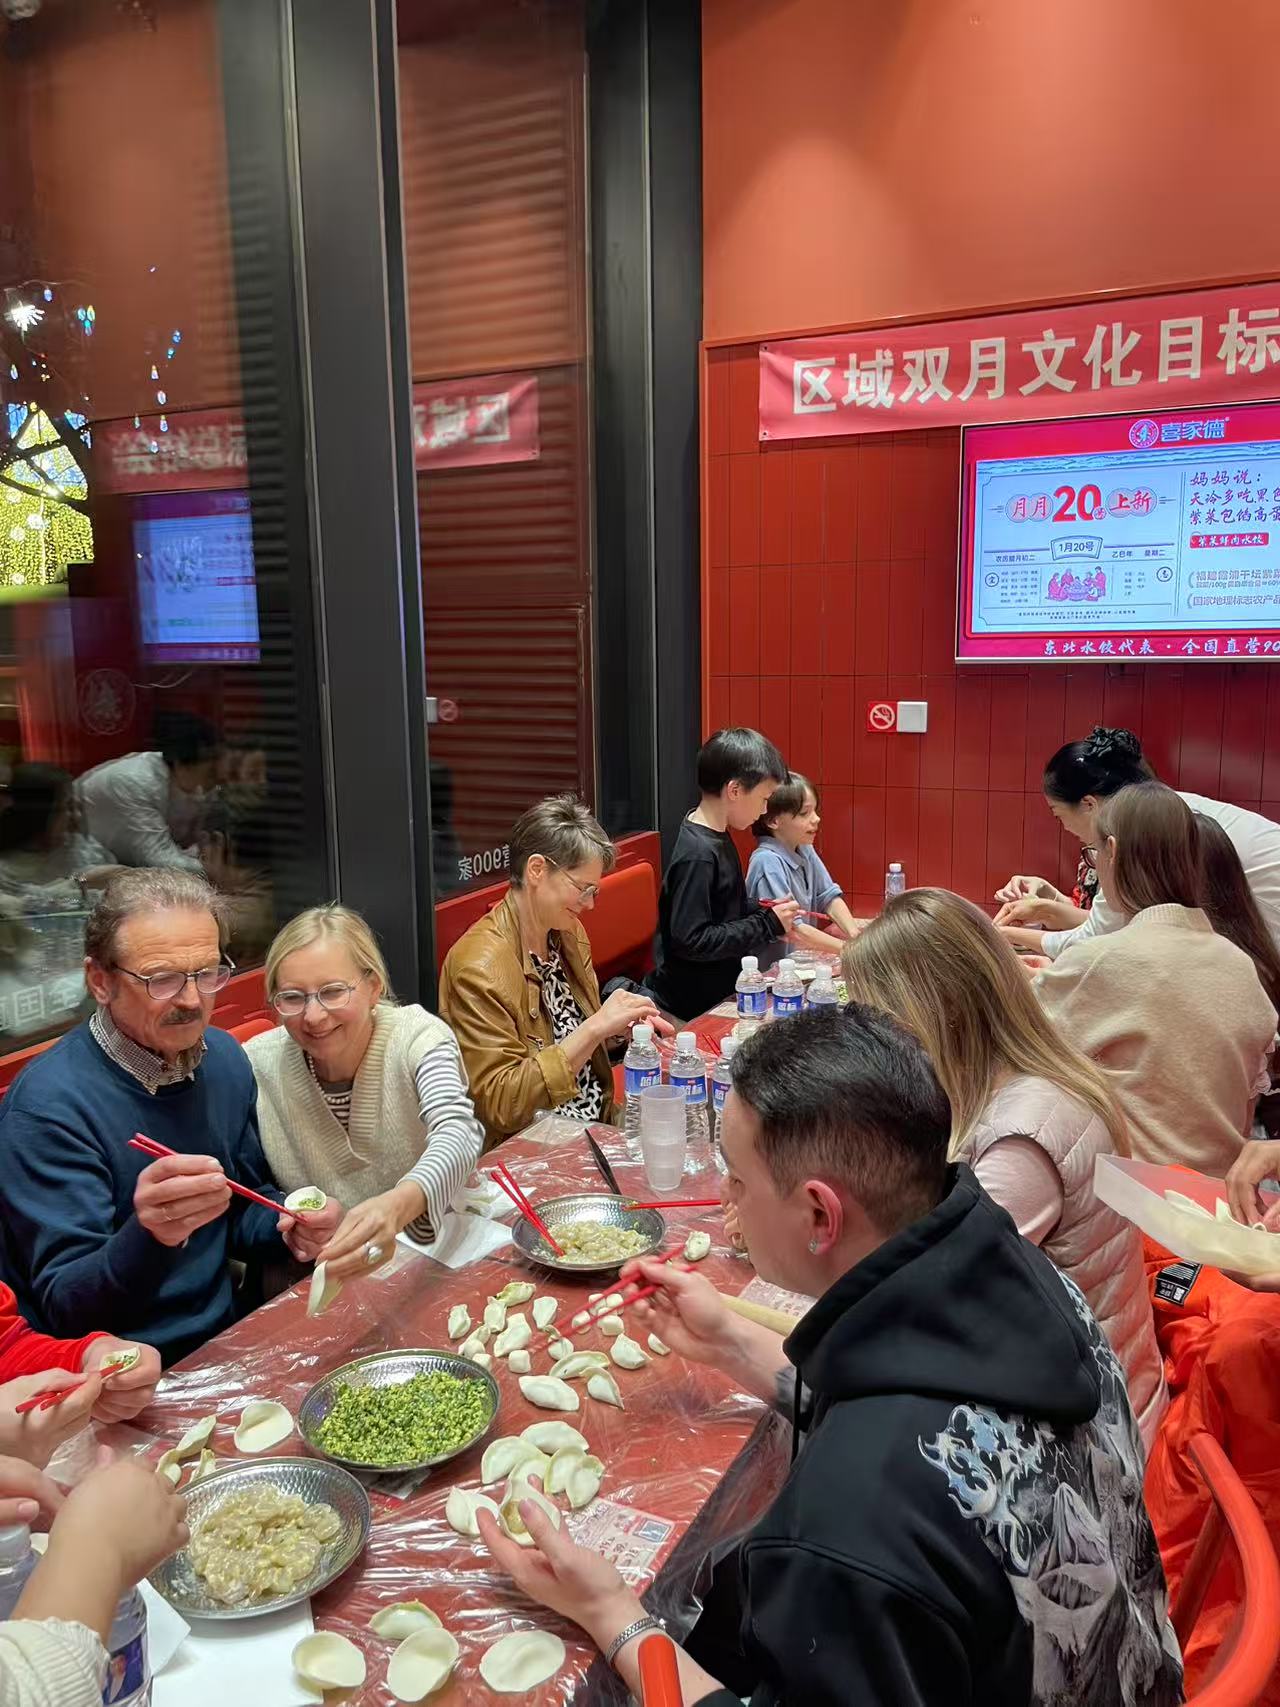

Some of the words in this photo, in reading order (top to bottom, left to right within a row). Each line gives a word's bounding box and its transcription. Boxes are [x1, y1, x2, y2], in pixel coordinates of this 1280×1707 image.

[793, 308, 1280, 414] 区域双月文化目标
[1161, 420, 1225, 442] 喜家德
[1059, 541, 1095, 553] 1月20号
